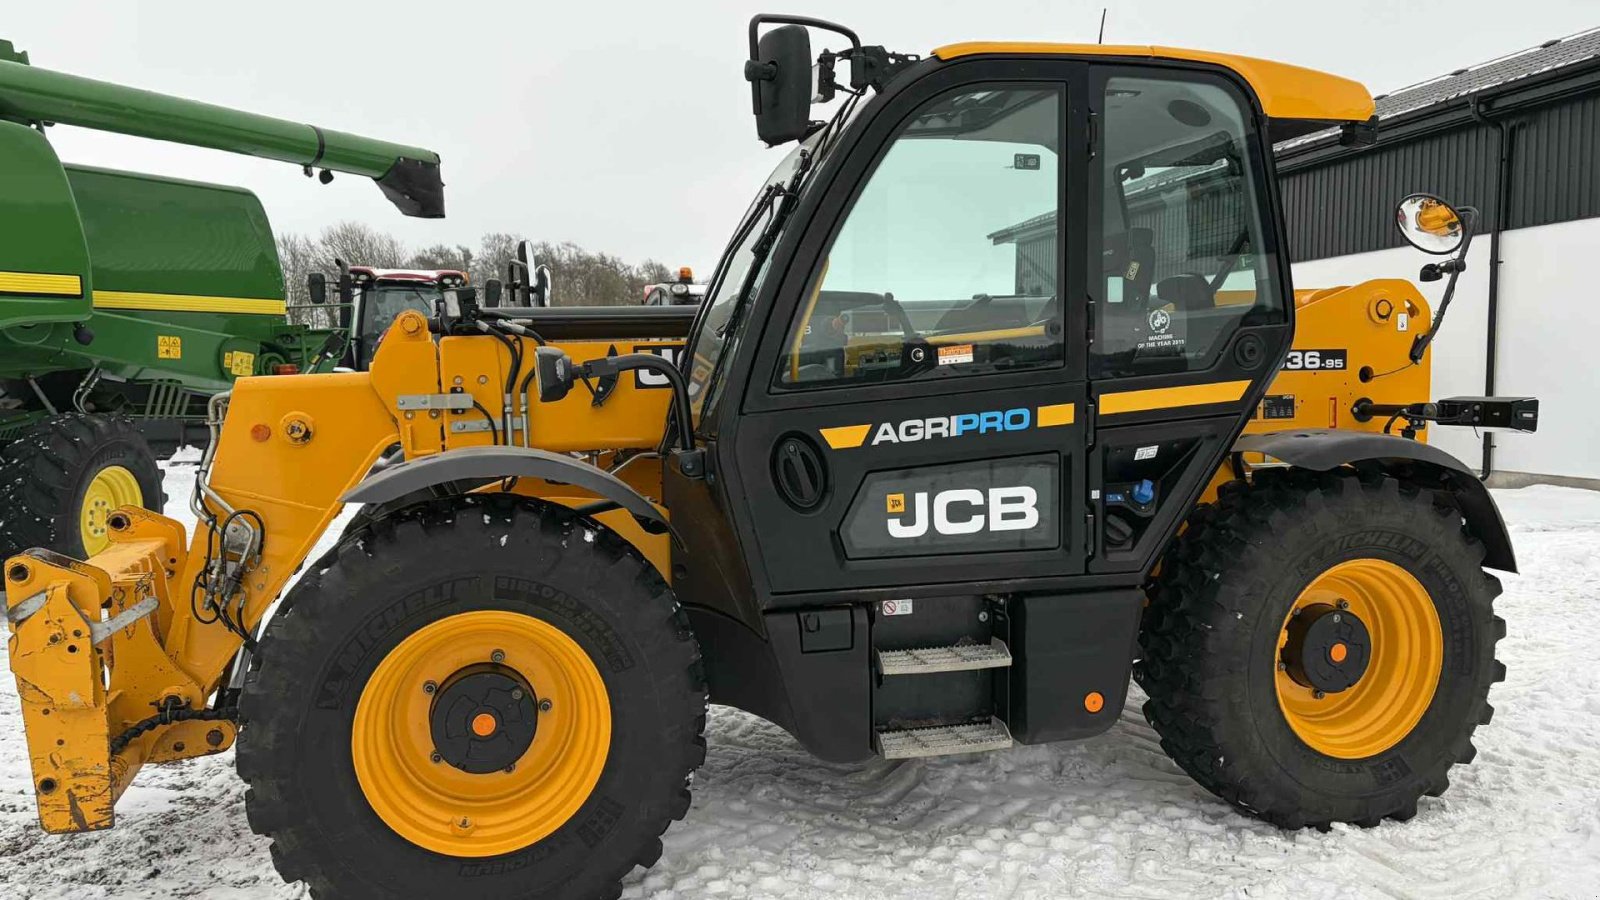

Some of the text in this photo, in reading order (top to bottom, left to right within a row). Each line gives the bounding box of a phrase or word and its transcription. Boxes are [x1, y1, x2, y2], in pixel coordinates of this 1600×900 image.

[1281, 351, 1344, 369] 36-95
[871, 408, 1031, 446] AGRIPRO
[887, 486, 1039, 538] JCB
